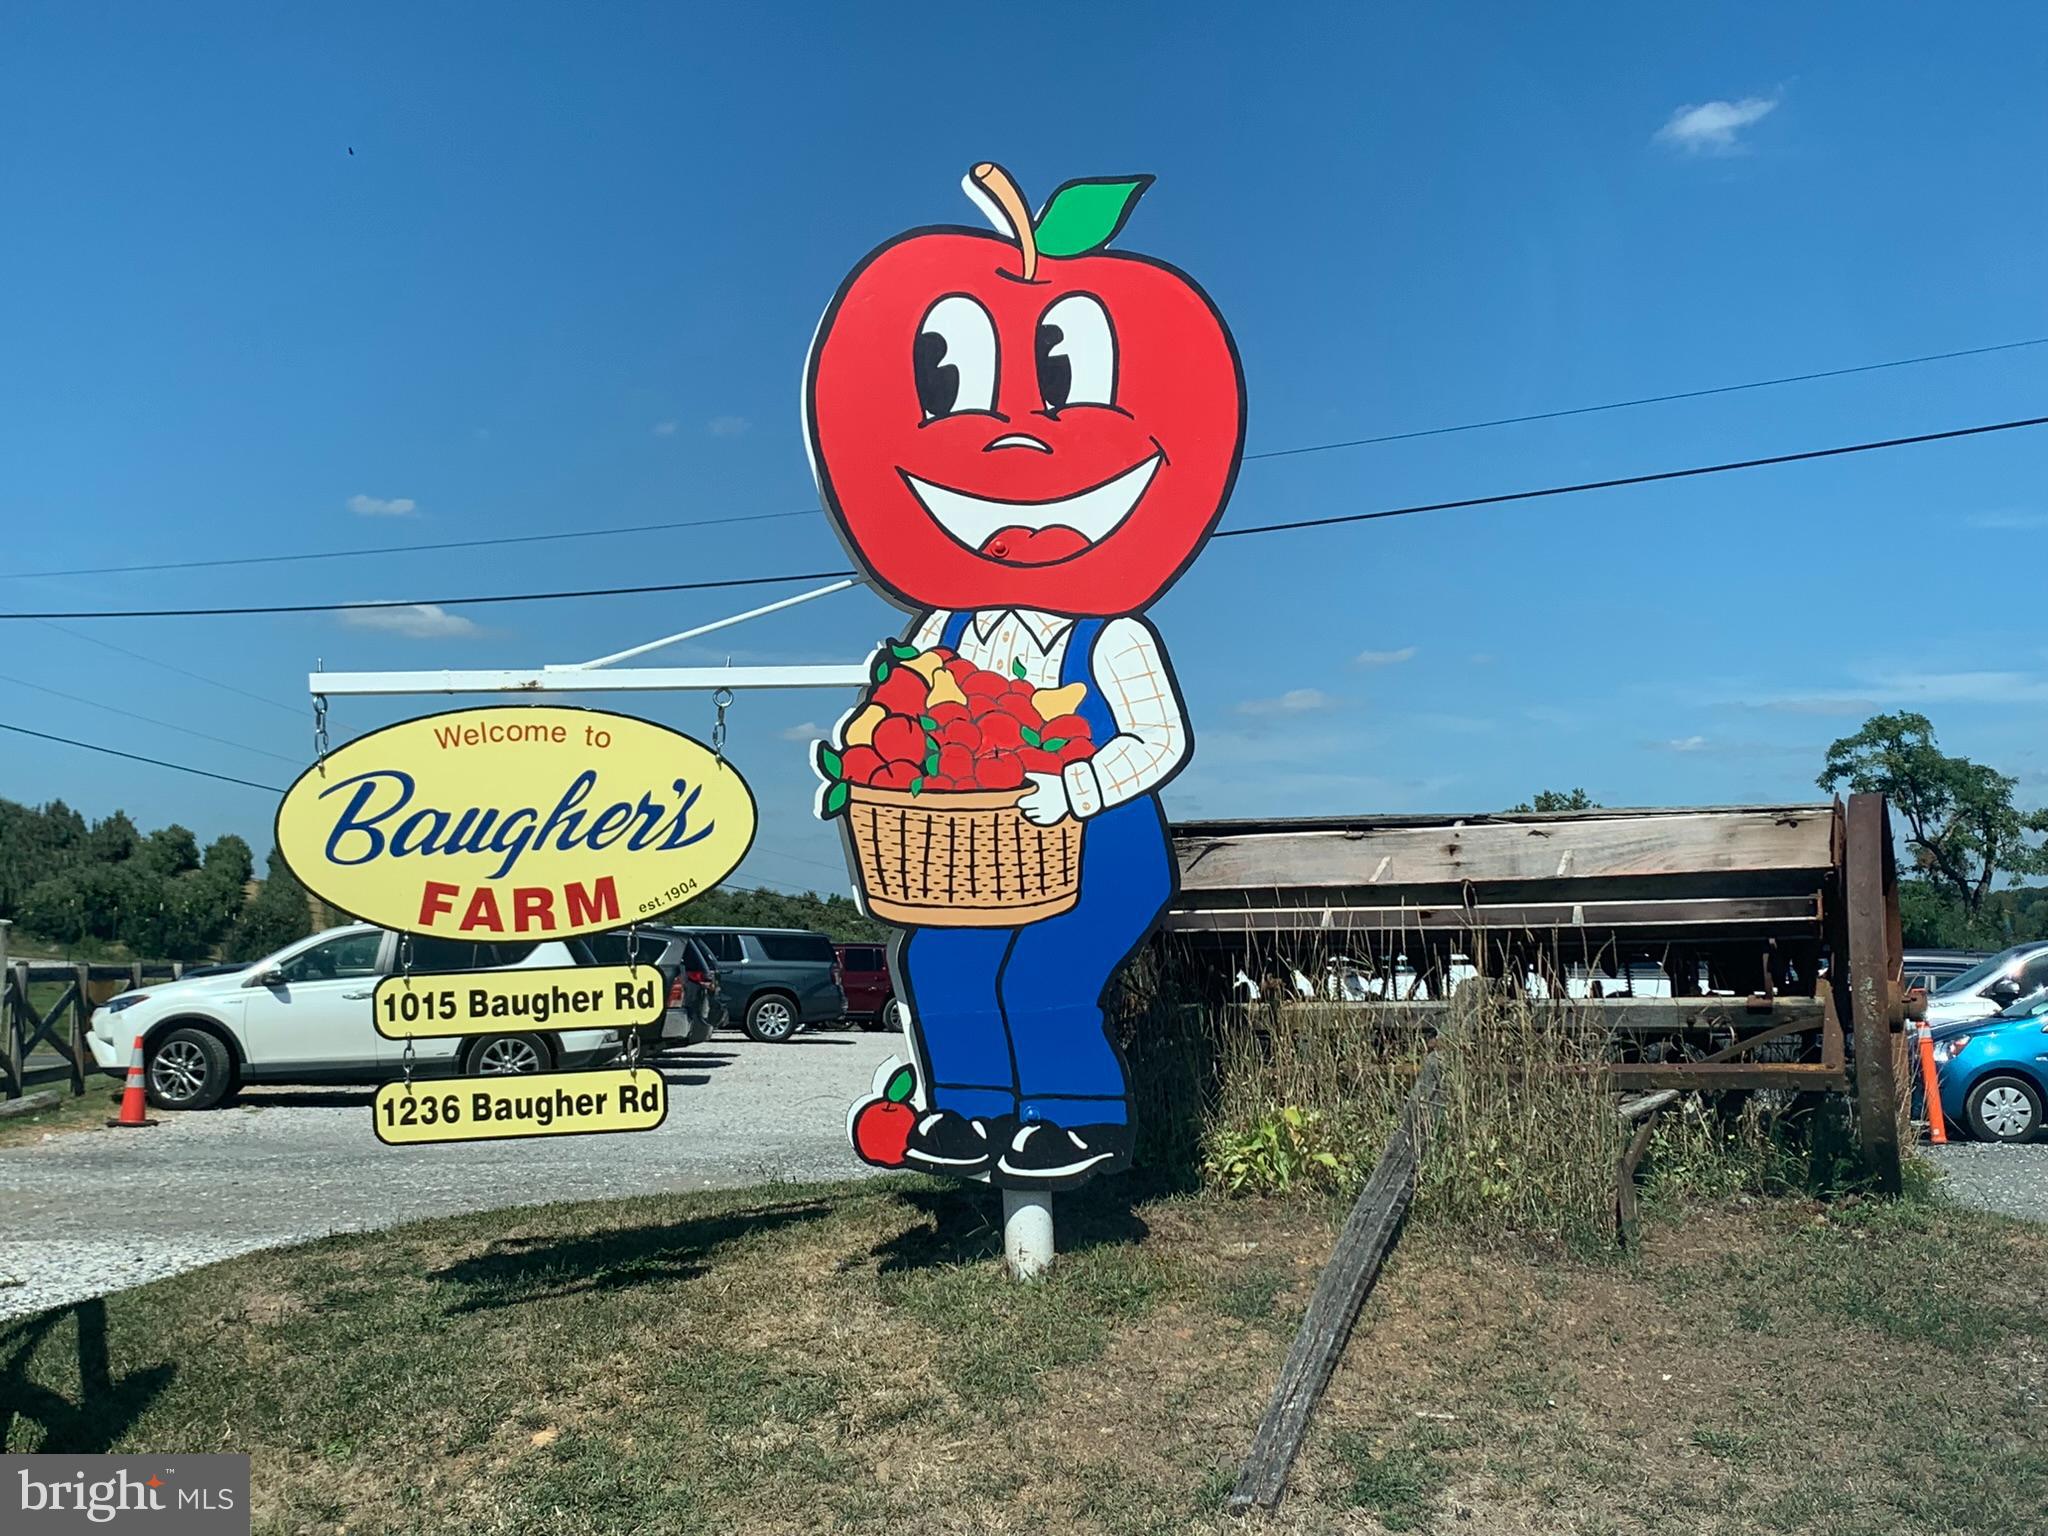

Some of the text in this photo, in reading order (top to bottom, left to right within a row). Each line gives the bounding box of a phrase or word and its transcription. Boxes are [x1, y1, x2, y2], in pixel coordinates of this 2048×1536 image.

[434, 721, 611, 750] Welcome to
[318, 770, 715, 880] Baugher's
[417, 876, 621, 933] FARM
[383, 980, 654, 1022] 1015 Baugher Rd
[382, 1084, 658, 1126] 1236 Baugher Rd
